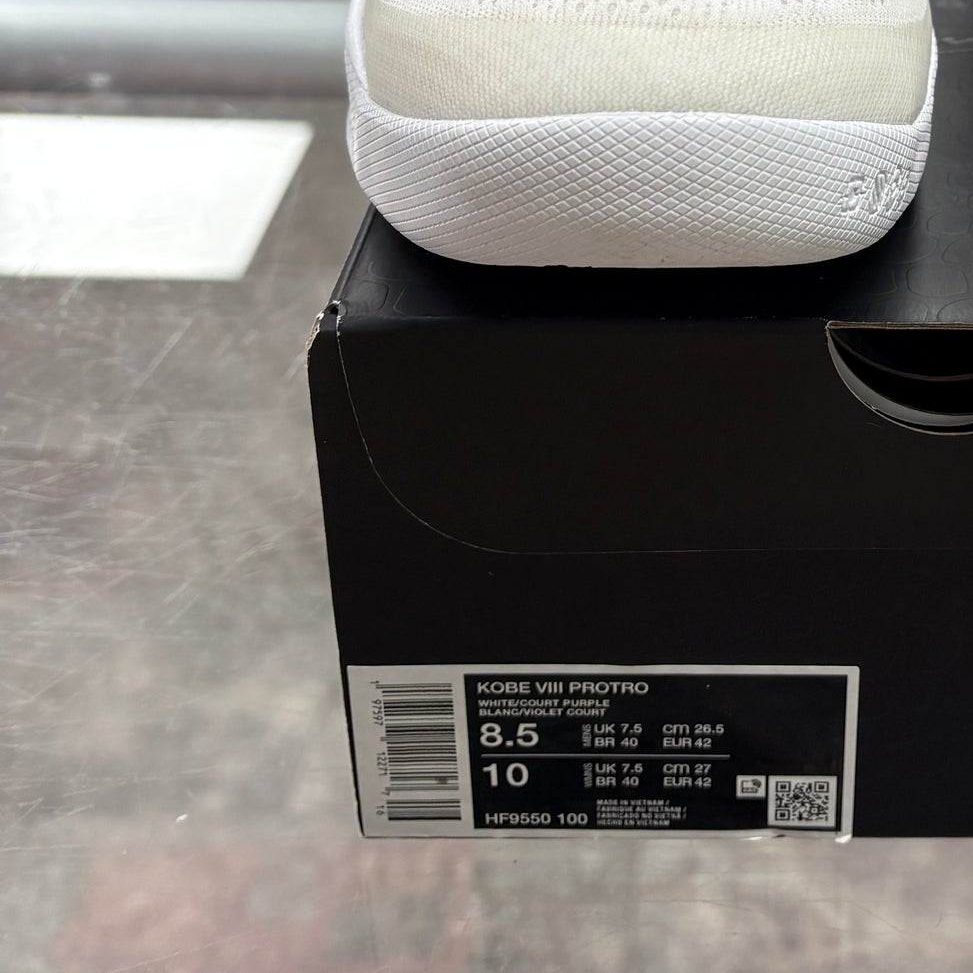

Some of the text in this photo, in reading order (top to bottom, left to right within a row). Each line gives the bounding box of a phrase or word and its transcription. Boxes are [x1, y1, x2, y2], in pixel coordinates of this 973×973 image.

[477, 681, 649, 694] KOBE VIII PROTRO
[478, 699, 610, 707] WHITE/COURT PURPLE
[479, 708, 605, 717] BLANC/VIOLET COURT
[480, 722, 539, 747] 8.5
[594, 724, 616, 735] UK
[621, 724, 642, 735] 7.5
[694, 724, 724, 735] 26.5
[594, 738, 712, 748] BR 40 EUR 42
[595, 763, 616, 774] UK
[622, 763, 643, 774] 7.5
[694, 763, 712, 774] 27
[482, 762, 529, 787] 10
[595, 777, 712, 787] BR 40 EUR 42
[485, 813, 588, 825] HF9550 100
